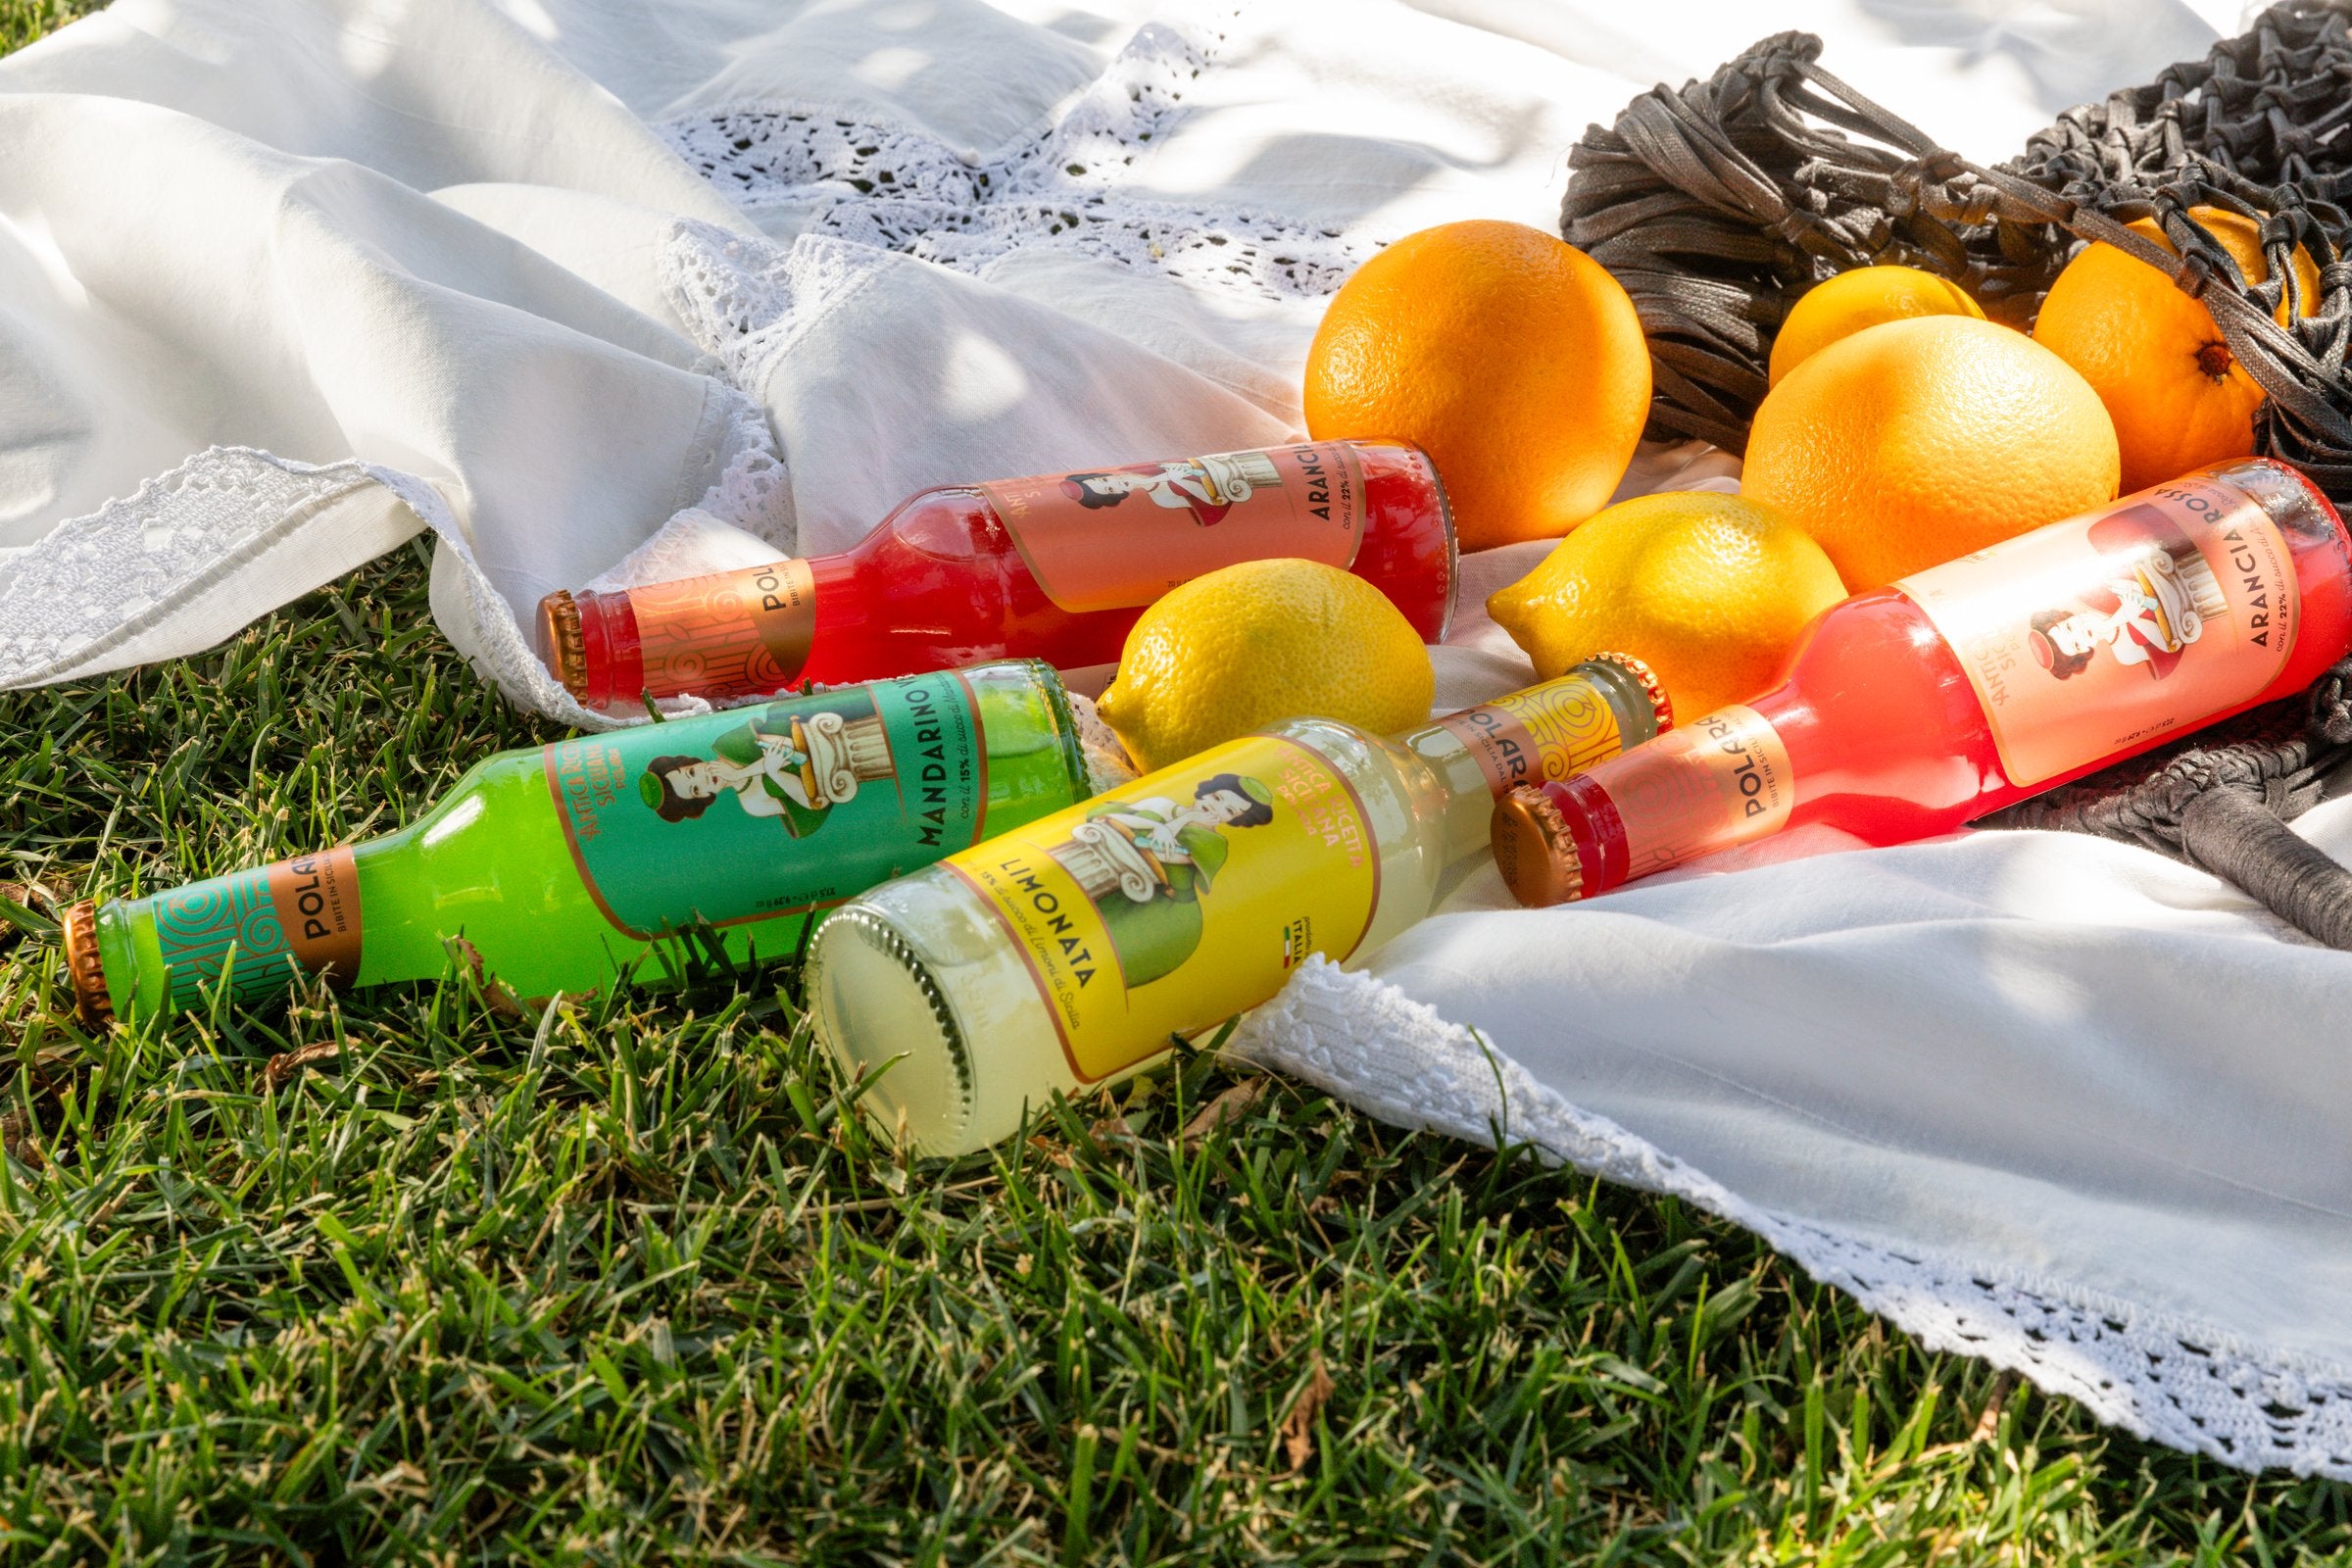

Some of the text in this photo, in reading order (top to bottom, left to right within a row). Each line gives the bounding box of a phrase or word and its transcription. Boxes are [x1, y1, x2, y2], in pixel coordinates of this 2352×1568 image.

[1340, 480, 1350, 501] 22%
[753, 565, 787, 612] POL
[2154, 489, 2269, 648] ARANCIA ROSSA
[2278, 593, 2287, 618] 22%
[1975, 647, 2010, 706] ANTIC
[905, 689, 948, 847] MANDARINO
[959, 759, 970, 784] 15%
[1474, 729, 1498, 762] SICILIA
[1495, 762, 1507, 783] DAL
[1693, 716, 1767, 818] POLARA
[567, 775, 602, 842] ANTICA
[1767, 779, 1780, 808] BIBITE
[331, 898, 347, 933] BIBITE
[1000, 858, 1097, 989] LIMONATA
[1293, 919, 1303, 965] ITALIA
[1030, 937, 1057, 977] Limoni
[1058, 992, 1081, 1030] Sicilia
